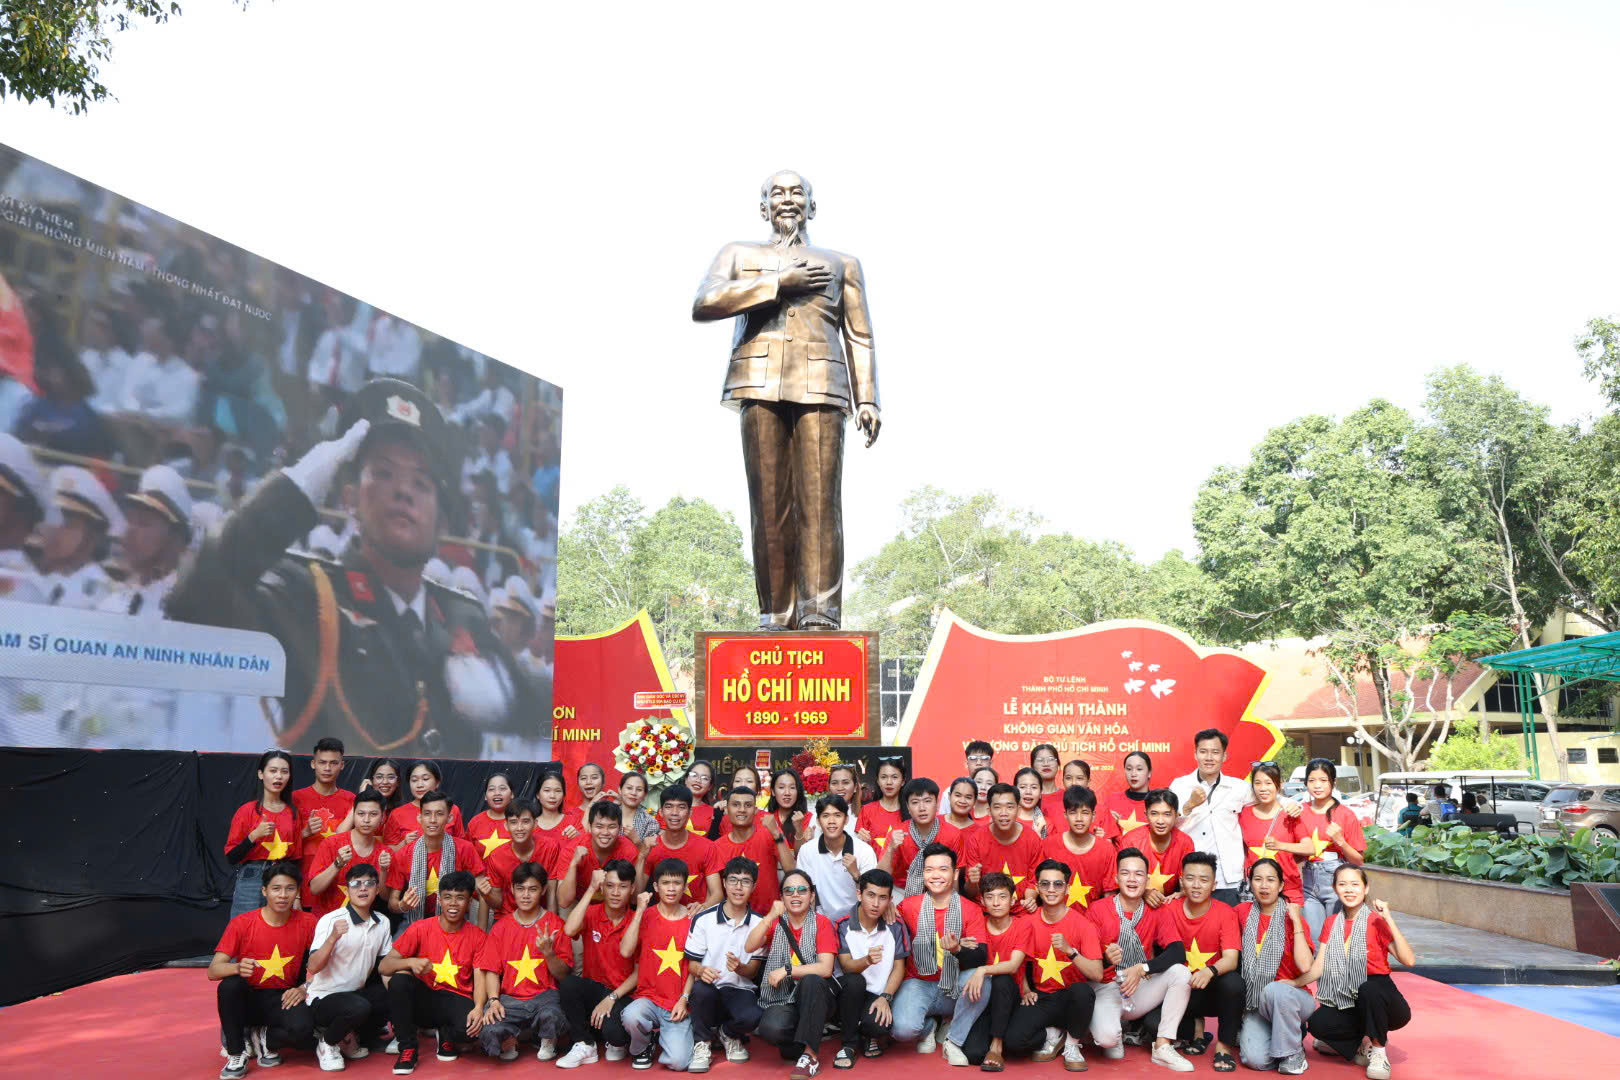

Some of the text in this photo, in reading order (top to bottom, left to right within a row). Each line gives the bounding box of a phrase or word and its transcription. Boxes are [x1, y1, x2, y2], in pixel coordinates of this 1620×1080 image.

[28, 634, 48, 652] SĨ
[54, 638, 107, 656] QUAN
[113, 643, 138, 659] AN
[143, 647, 185, 664] NINH
[190, 651, 233, 668] NHÂN
[239, 655, 270, 672] DÂN
[750, 646, 824, 669] CHỦ TỊCH
[723, 668, 851, 702] HỒ CHÍ MINH
[1047, 684, 1062, 692] PHỐ
[1064, 684, 1075, 692] HỒ
[553, 705, 575, 719] ƠN
[1003, 697, 1127, 715] LỄ KHÁNH THÀNH
[745, 711, 780, 724] 1890
[793, 711, 828, 724] 1969
[563, 728, 601, 741] MINH
[1003, 722, 1129, 735] KHÔNG GIAN VĂN HÓA
[1071, 742, 1096, 755] TỊCH
[1099, 737, 1115, 752] HỒ
[1118, 740, 1139, 752] CHÍ
[1142, 742, 1170, 752] MINH
